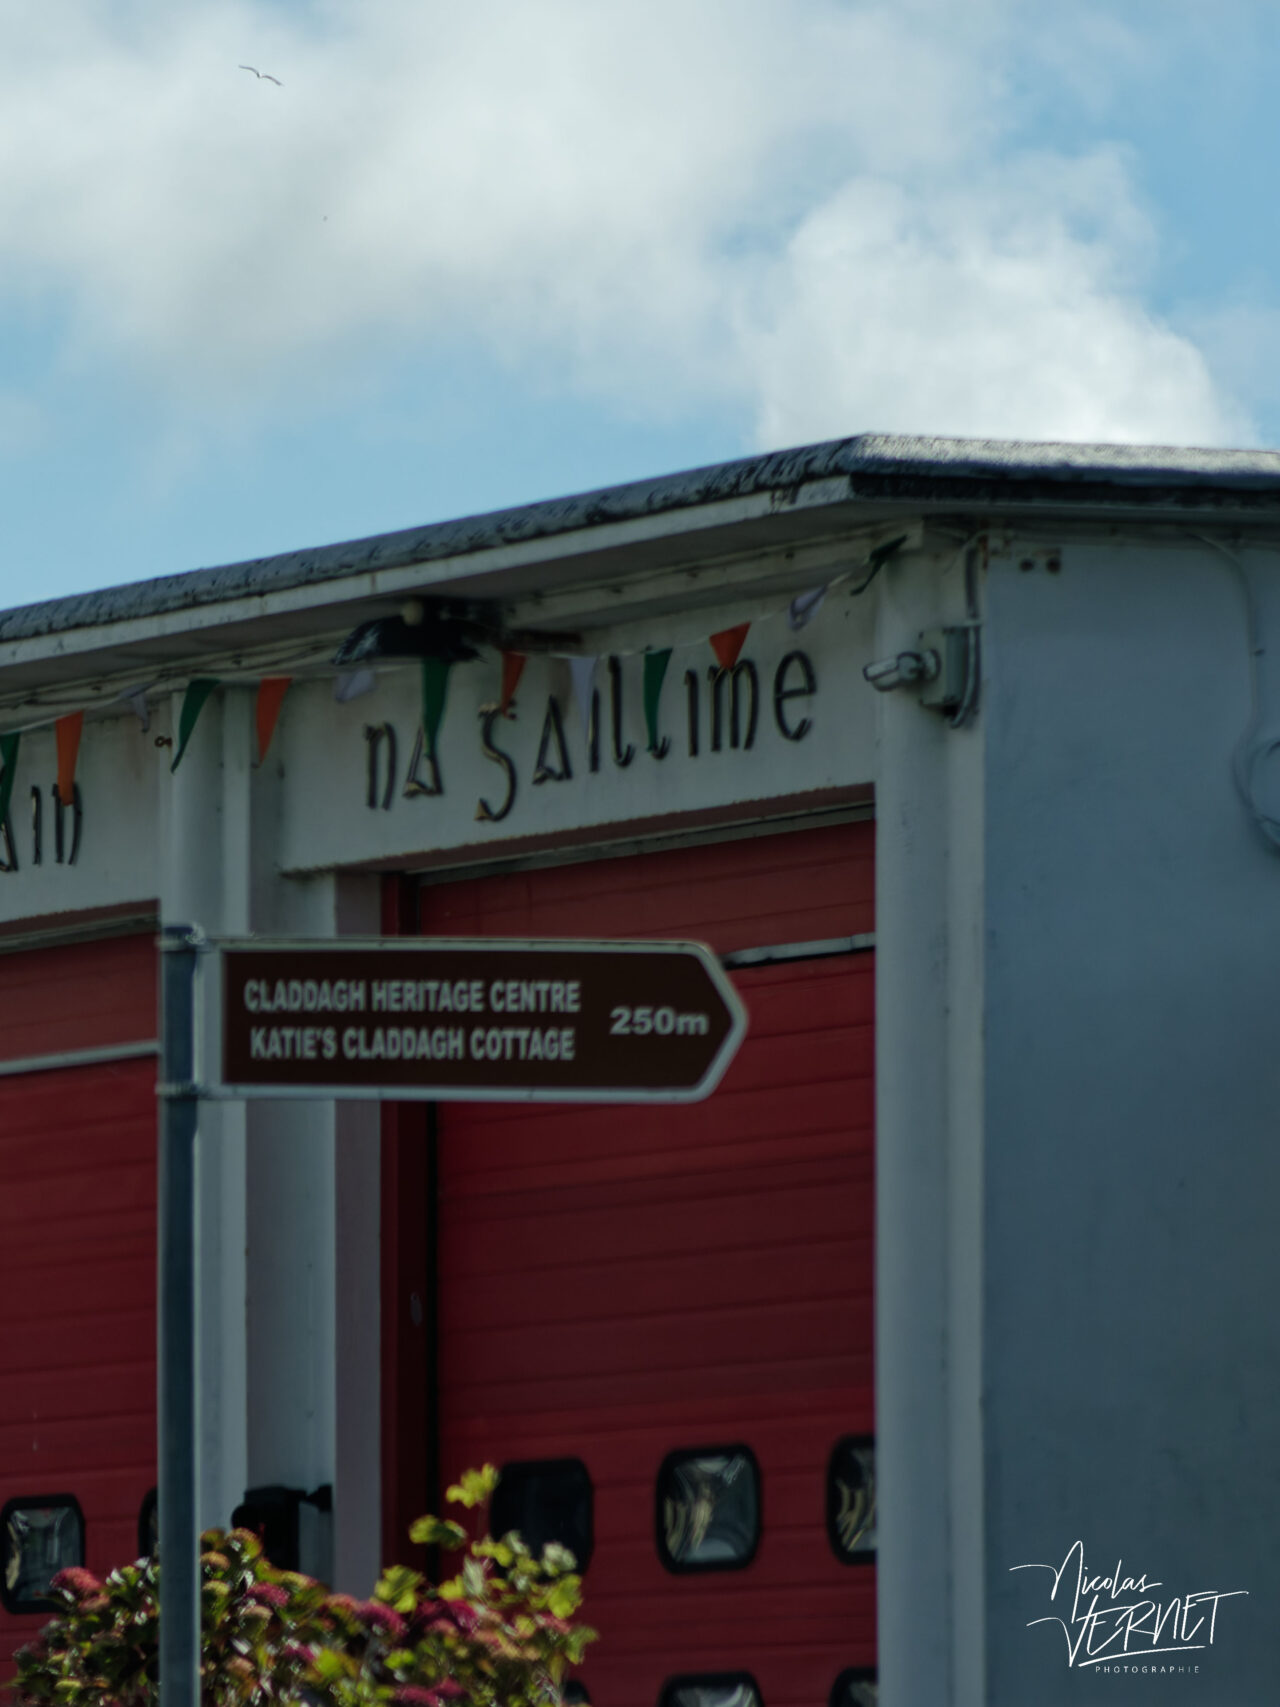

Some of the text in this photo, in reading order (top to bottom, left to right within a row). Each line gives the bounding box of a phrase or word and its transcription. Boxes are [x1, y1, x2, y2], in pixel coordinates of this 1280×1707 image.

[244, 980, 581, 1013] CLADDAGH HERITAGE CENTRE
[610, 1006, 709, 1035] 250m
[250, 1027, 576, 1061] KATIE'S CLADDAGH COTTAGE
